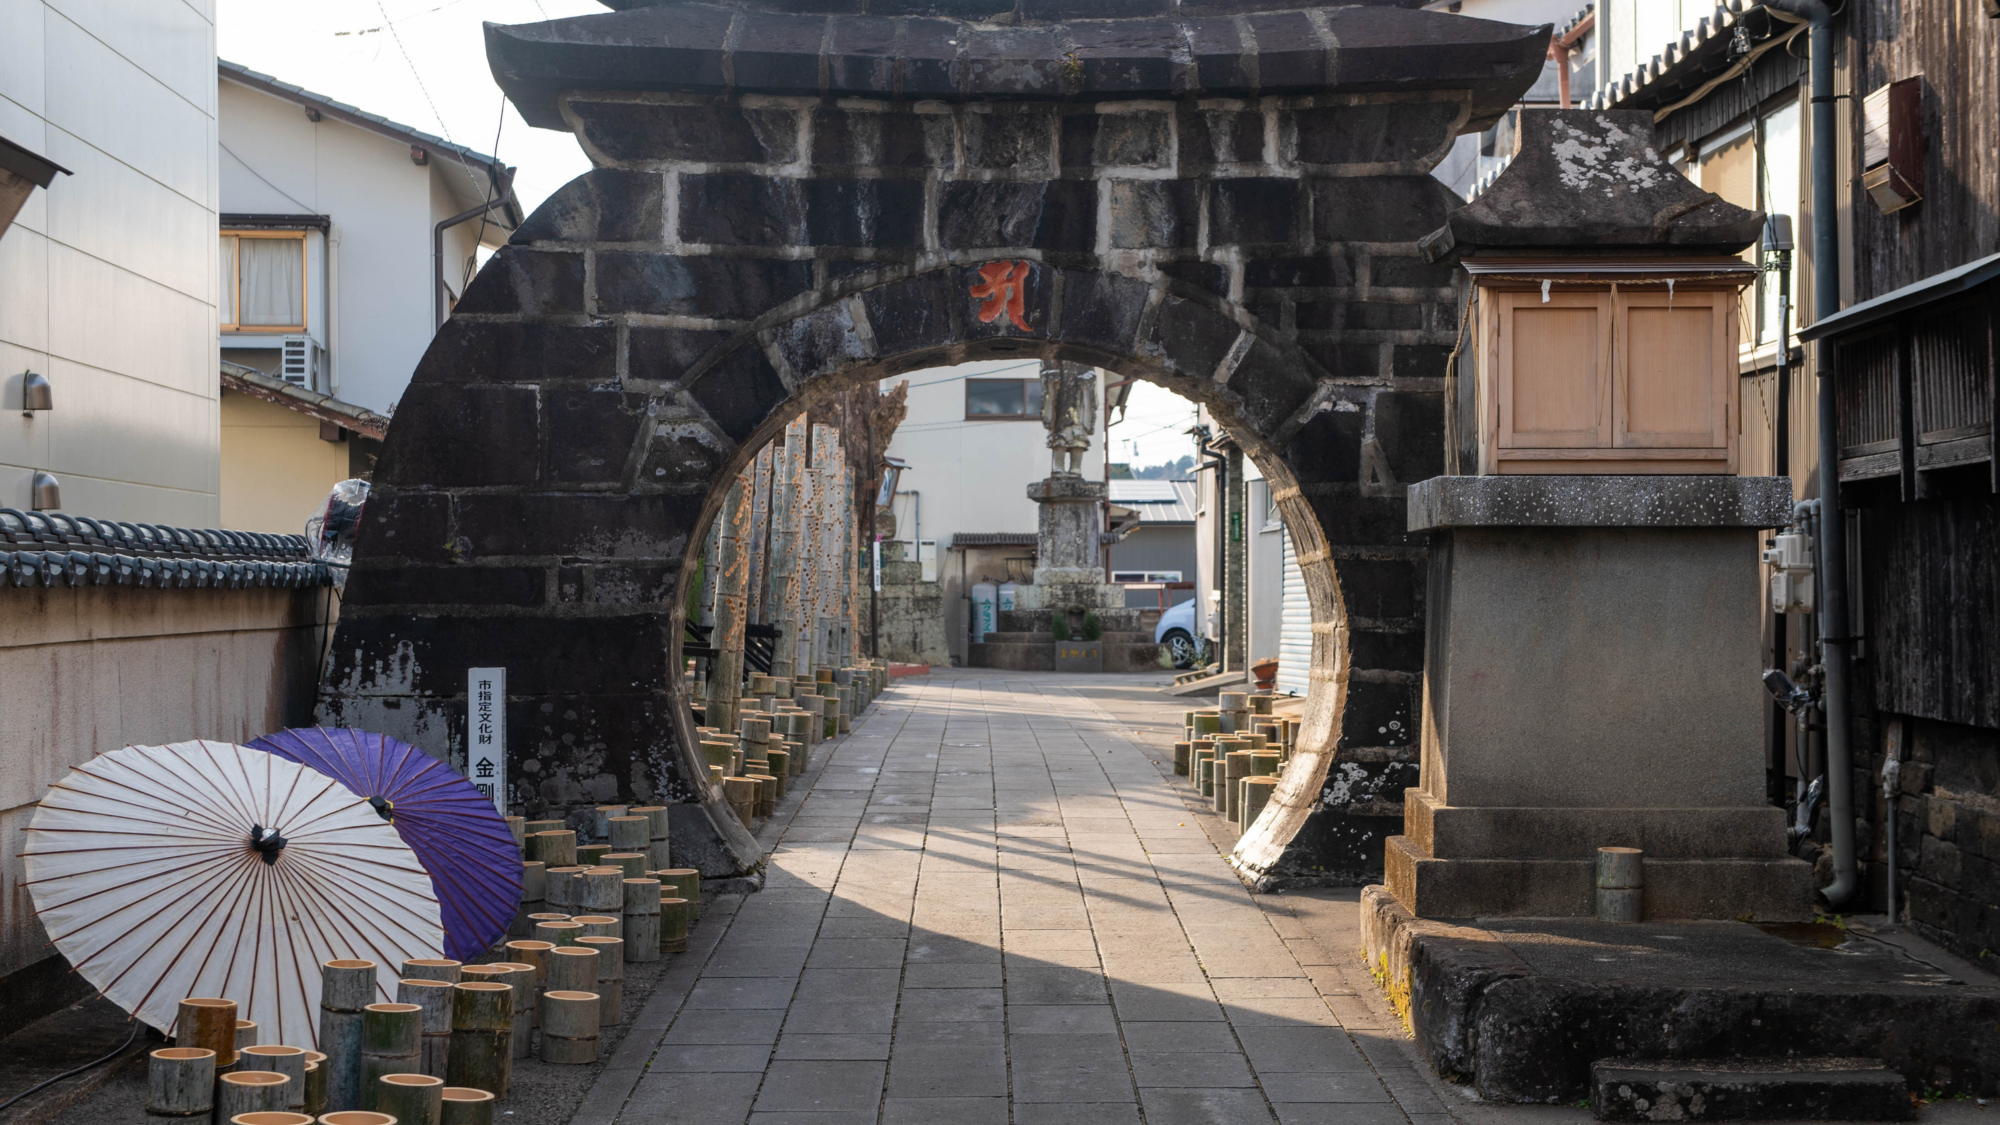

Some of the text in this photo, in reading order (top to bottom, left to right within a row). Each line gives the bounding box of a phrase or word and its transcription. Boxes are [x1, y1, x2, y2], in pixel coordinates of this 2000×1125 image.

[478, 680, 493, 745] 市指定文化財
